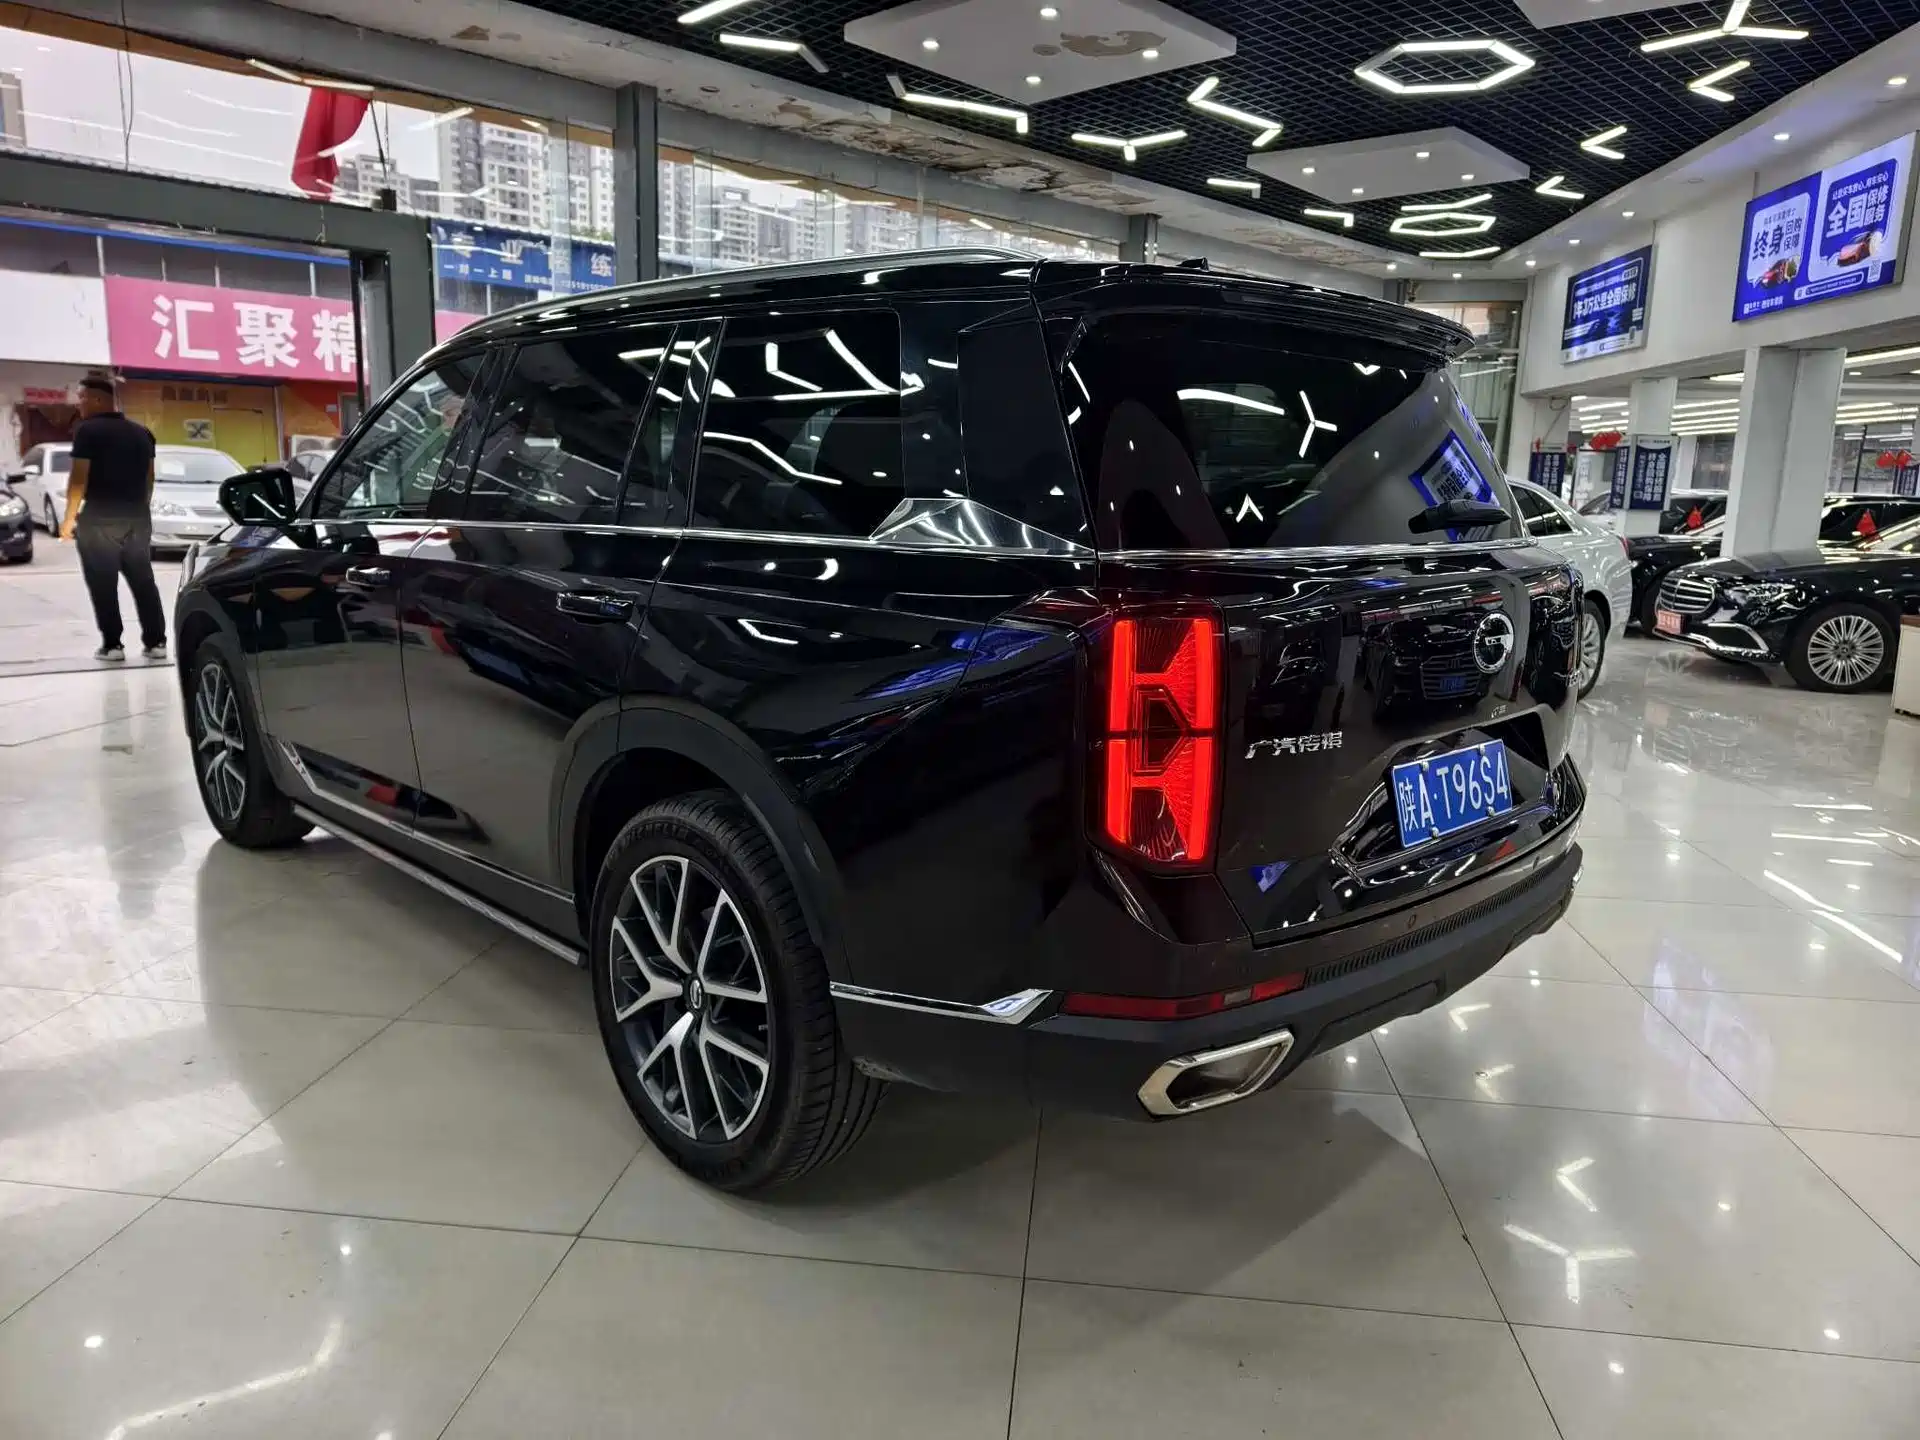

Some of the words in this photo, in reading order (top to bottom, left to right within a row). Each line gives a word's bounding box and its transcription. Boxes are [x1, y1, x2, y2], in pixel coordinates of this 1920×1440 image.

[1867, 184, 1890, 208] 保修
[1784, 217, 1803, 236] 回购
[1825, 192, 1868, 238] 全国
[1863, 205, 1886, 226] 服务
[1752, 224, 1784, 261] 终身
[1244, 730, 1343, 759] 广汽传祺
